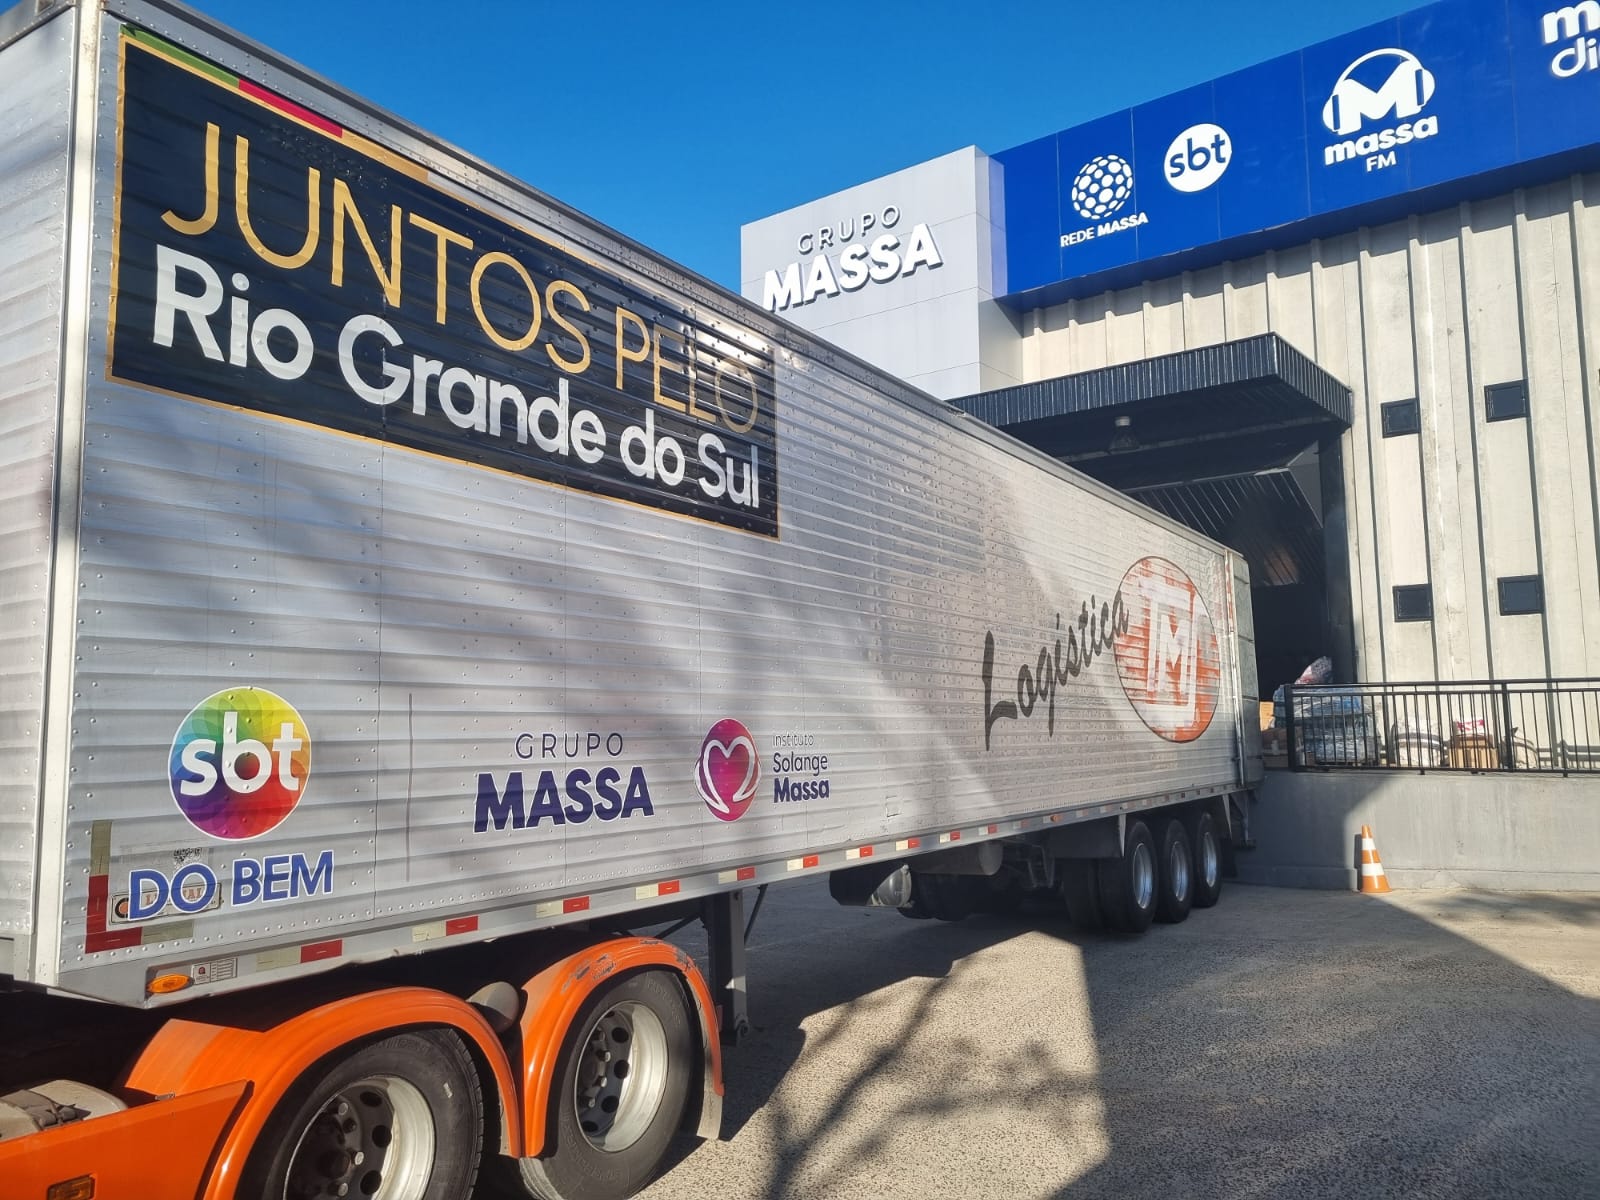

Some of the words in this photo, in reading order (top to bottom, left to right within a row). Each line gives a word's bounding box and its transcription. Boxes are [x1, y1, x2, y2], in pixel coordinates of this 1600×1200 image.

[1551, 36, 1600, 77] di
[1169, 133, 1227, 178] sbt
[1324, 115, 1439, 166] massa
[1366, 151, 1397, 172] FM
[798, 204, 901, 255] GRUPO
[1060, 227, 1095, 248] REDE
[1097, 211, 1149, 237] MASSA
[160, 121, 591, 374] JUNTOS
[615, 306, 759, 434] PELO
[763, 223, 944, 312] MASSA
[153, 244, 314, 380] Rio
[338, 314, 607, 464] Grande
[620, 408, 685, 486] do
[698, 432, 760, 508] Sul
[180, 711, 302, 796] sbt
[515, 732, 624, 760] GRUPO
[773, 750, 828, 777] Solange
[474, 766, 655, 833] MASSA
[773, 777, 830, 804] Massa
[127, 862, 218, 922] DO
[231, 849, 335, 907] BEM
